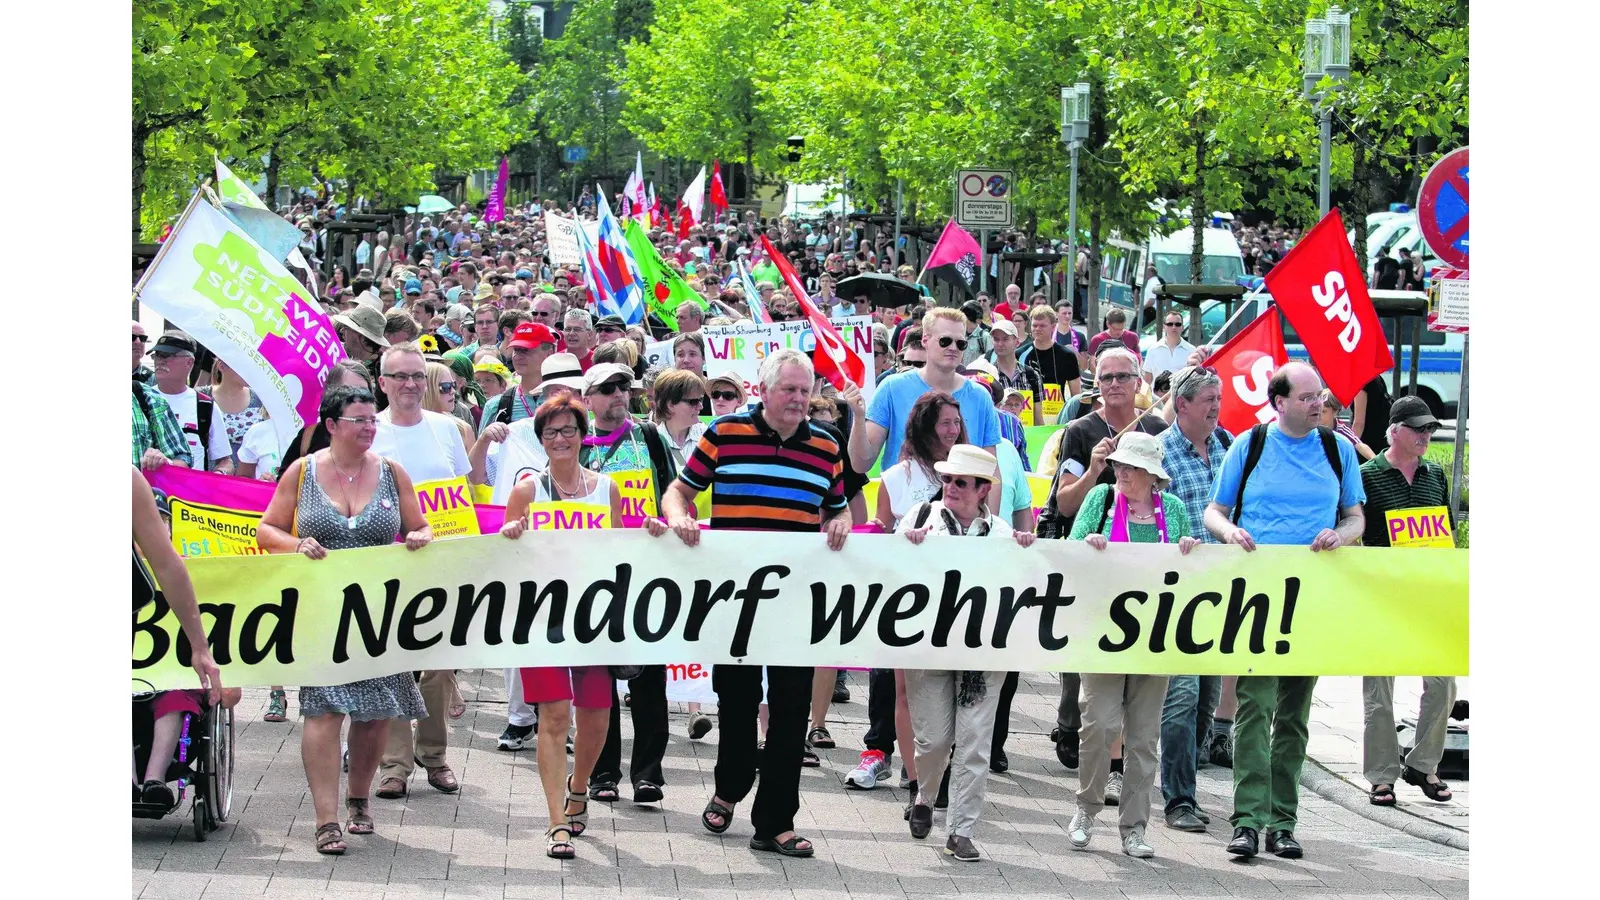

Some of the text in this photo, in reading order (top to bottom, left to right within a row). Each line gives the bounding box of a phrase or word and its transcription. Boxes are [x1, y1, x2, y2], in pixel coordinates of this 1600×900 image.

[217, 252, 340, 365] NETZWER
[1311, 270, 1362, 353] SPD
[206, 271, 329, 388] SÜDHEIDE
[707, 337, 745, 360] WIR
[417, 485, 470, 514] MK
[181, 508, 257, 538] Bad Nenndo
[533, 510, 605, 530] PMK
[1389, 514, 1450, 542] PMK
[182, 537, 211, 556] ist
[132, 563, 1301, 670] Bad Nenndorf wehrt sich!
